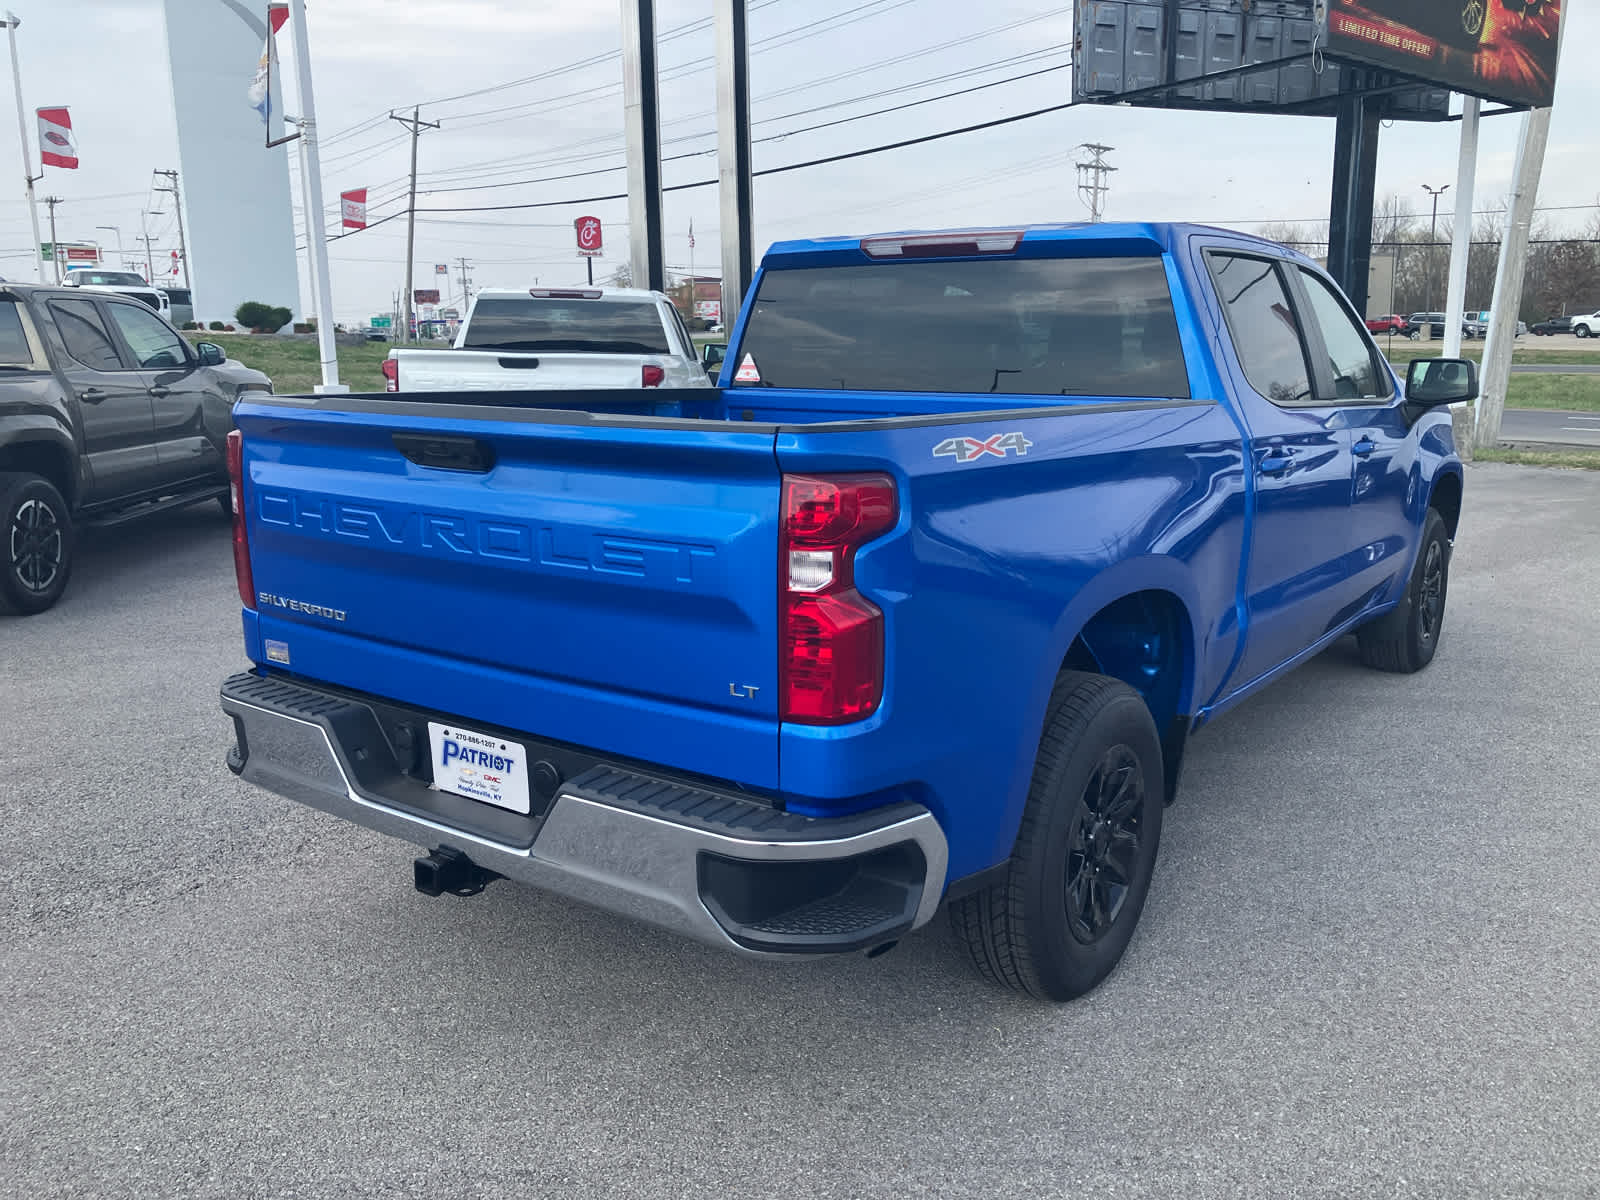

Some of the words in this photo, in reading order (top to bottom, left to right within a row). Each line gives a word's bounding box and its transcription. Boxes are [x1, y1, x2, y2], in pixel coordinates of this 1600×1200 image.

[1339, 19, 1378, 39] LIMITED
[1379, 31, 1401, 47] TIME
[1402, 38, 1431, 56] OFFER!
[257, 492, 716, 584] CHEVROLET
[258, 592, 346, 622] SILVERADO
[729, 682, 760, 699] LT
[442, 740, 514, 773] PATRIOT
[483, 774, 502, 784] GMC
[493, 792, 503, 801] KY
